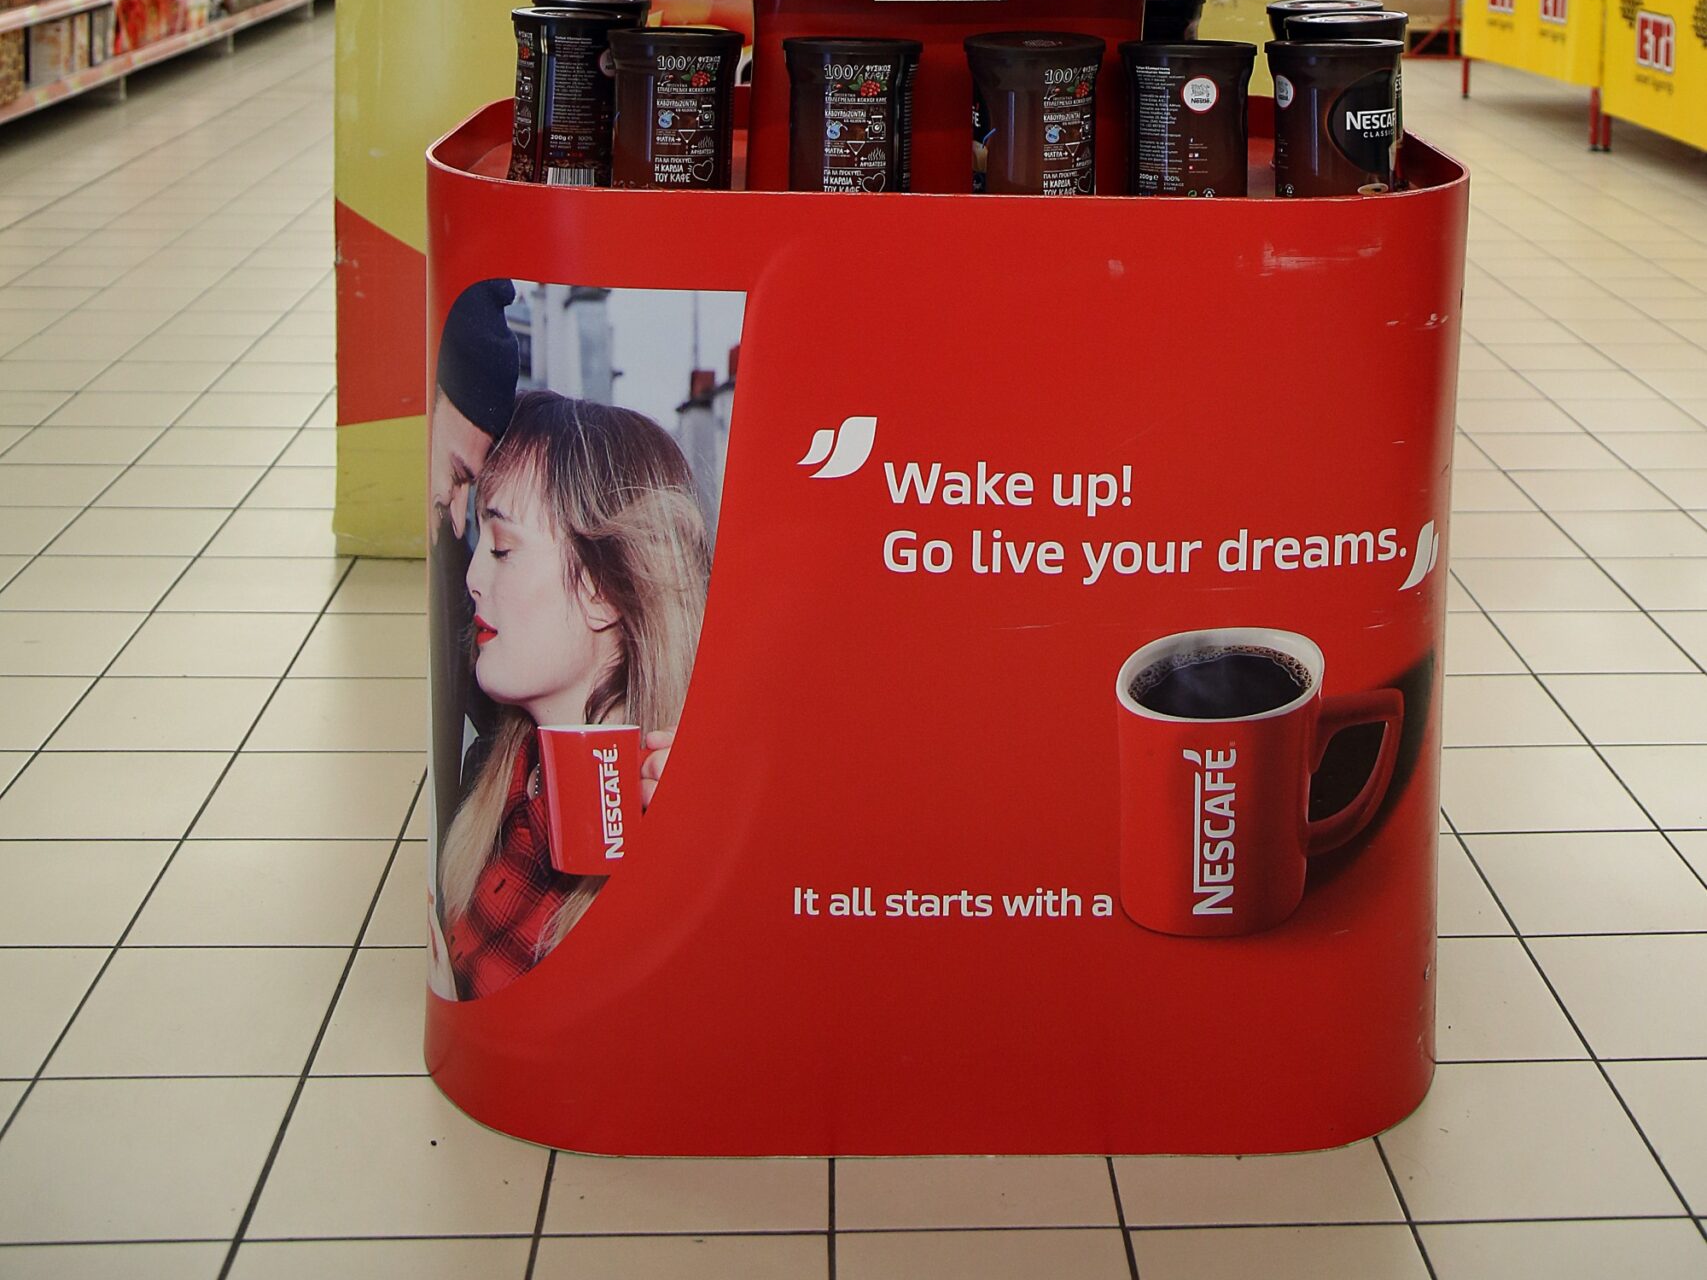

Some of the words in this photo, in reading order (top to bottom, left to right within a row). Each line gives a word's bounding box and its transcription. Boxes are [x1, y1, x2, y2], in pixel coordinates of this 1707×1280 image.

[656, 55, 697, 71] 100%
[823, 63, 864, 80] 100%
[1044, 67, 1082, 84] 100%
[884, 461, 1034, 506] Wake
[1052, 465, 1133, 517] up!
[883, 530, 954, 574] Go
[971, 529, 1065, 575] live
[1081, 538, 1203, 585] your
[1217, 527, 1408, 572] dreams.
[592, 748, 625, 859] NESCAFÉ
[1182, 748, 1237, 915] NESCAFÉ
[793, 887, 820, 916] It
[828, 887, 877, 917] all
[885, 889, 994, 917] starts
[1001, 887, 1083, 917] with
[1091, 893, 1113, 917] a
